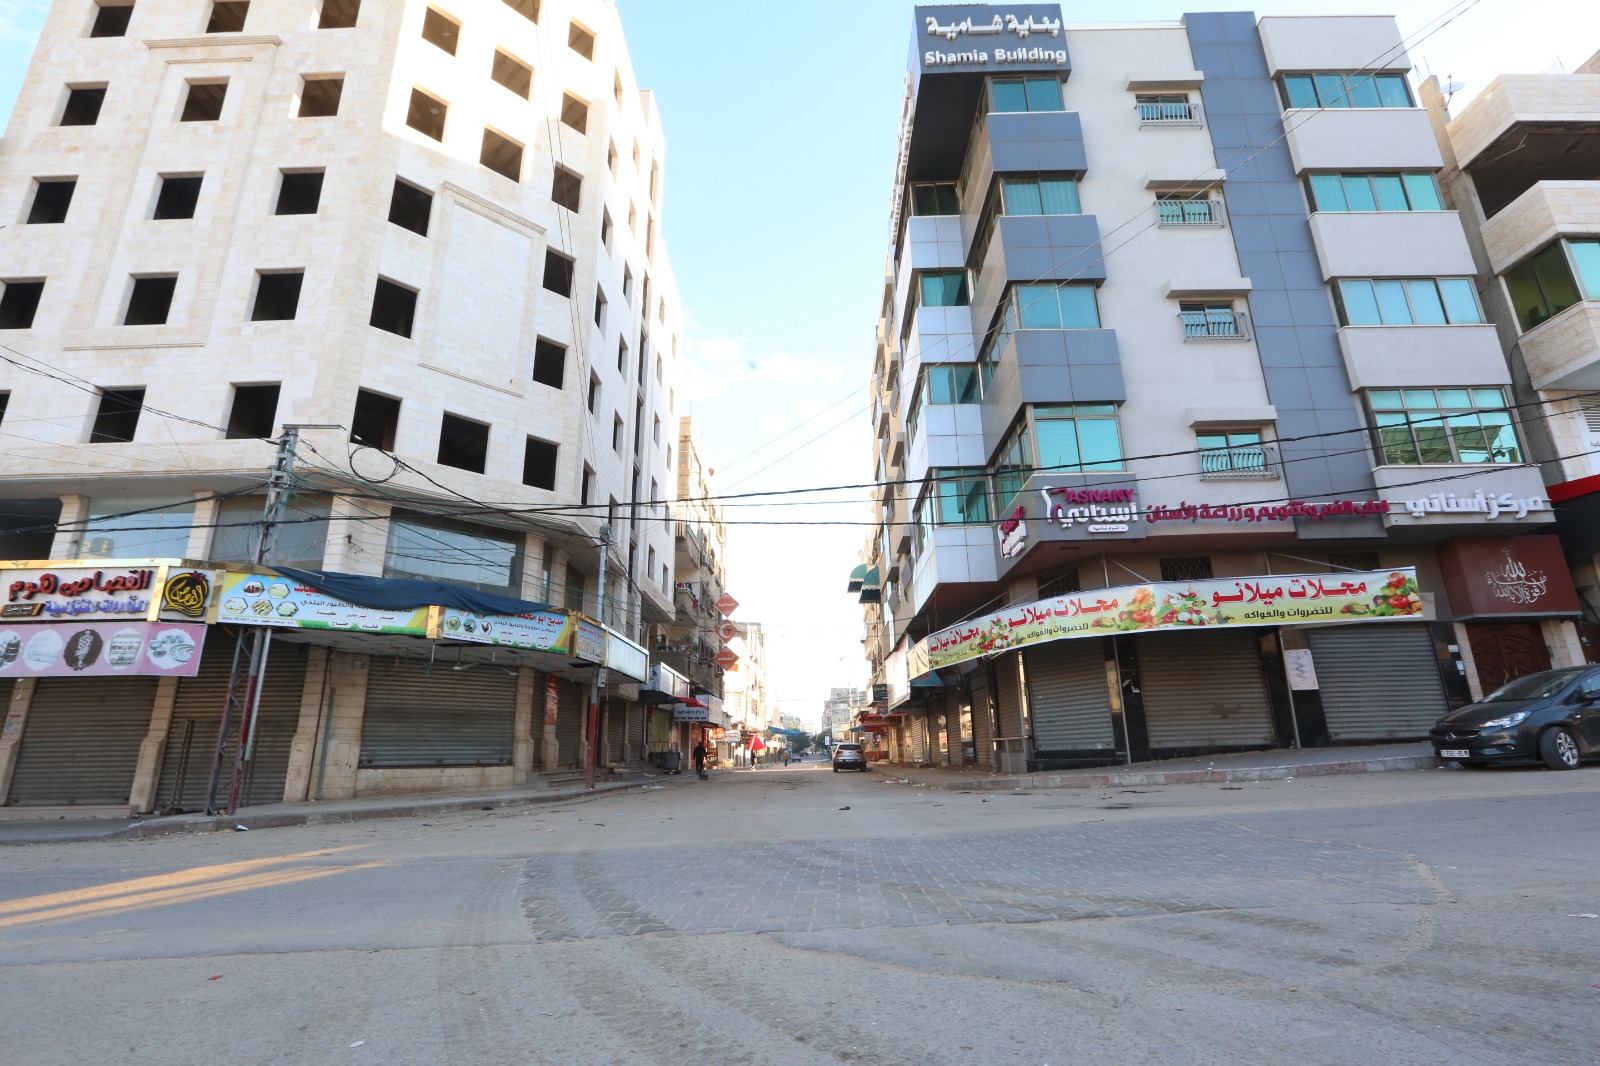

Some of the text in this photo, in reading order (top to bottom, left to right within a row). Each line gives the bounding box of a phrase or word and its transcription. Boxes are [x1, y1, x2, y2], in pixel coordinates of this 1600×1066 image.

[925, 14, 1061, 40] بناية شامية
[924, 47, 1067, 66] Shamia Building
[1067, 488, 1134, 504] ASNANY
[1405, 489, 1544, 520] مركز أسناني
[1146, 501, 1199, 523] الأسنان
[1319, 500, 1354, 520] الفم
[9, 573, 58, 601] هوم
[1211, 578, 1368, 608] محلات ميلانو
[1008, 597, 1119, 632] محلات ميلانو
[1244, 606, 1333, 620] للخضروات والفواكه
[1026, 622, 1089, 639] للخضروات والفواكه
